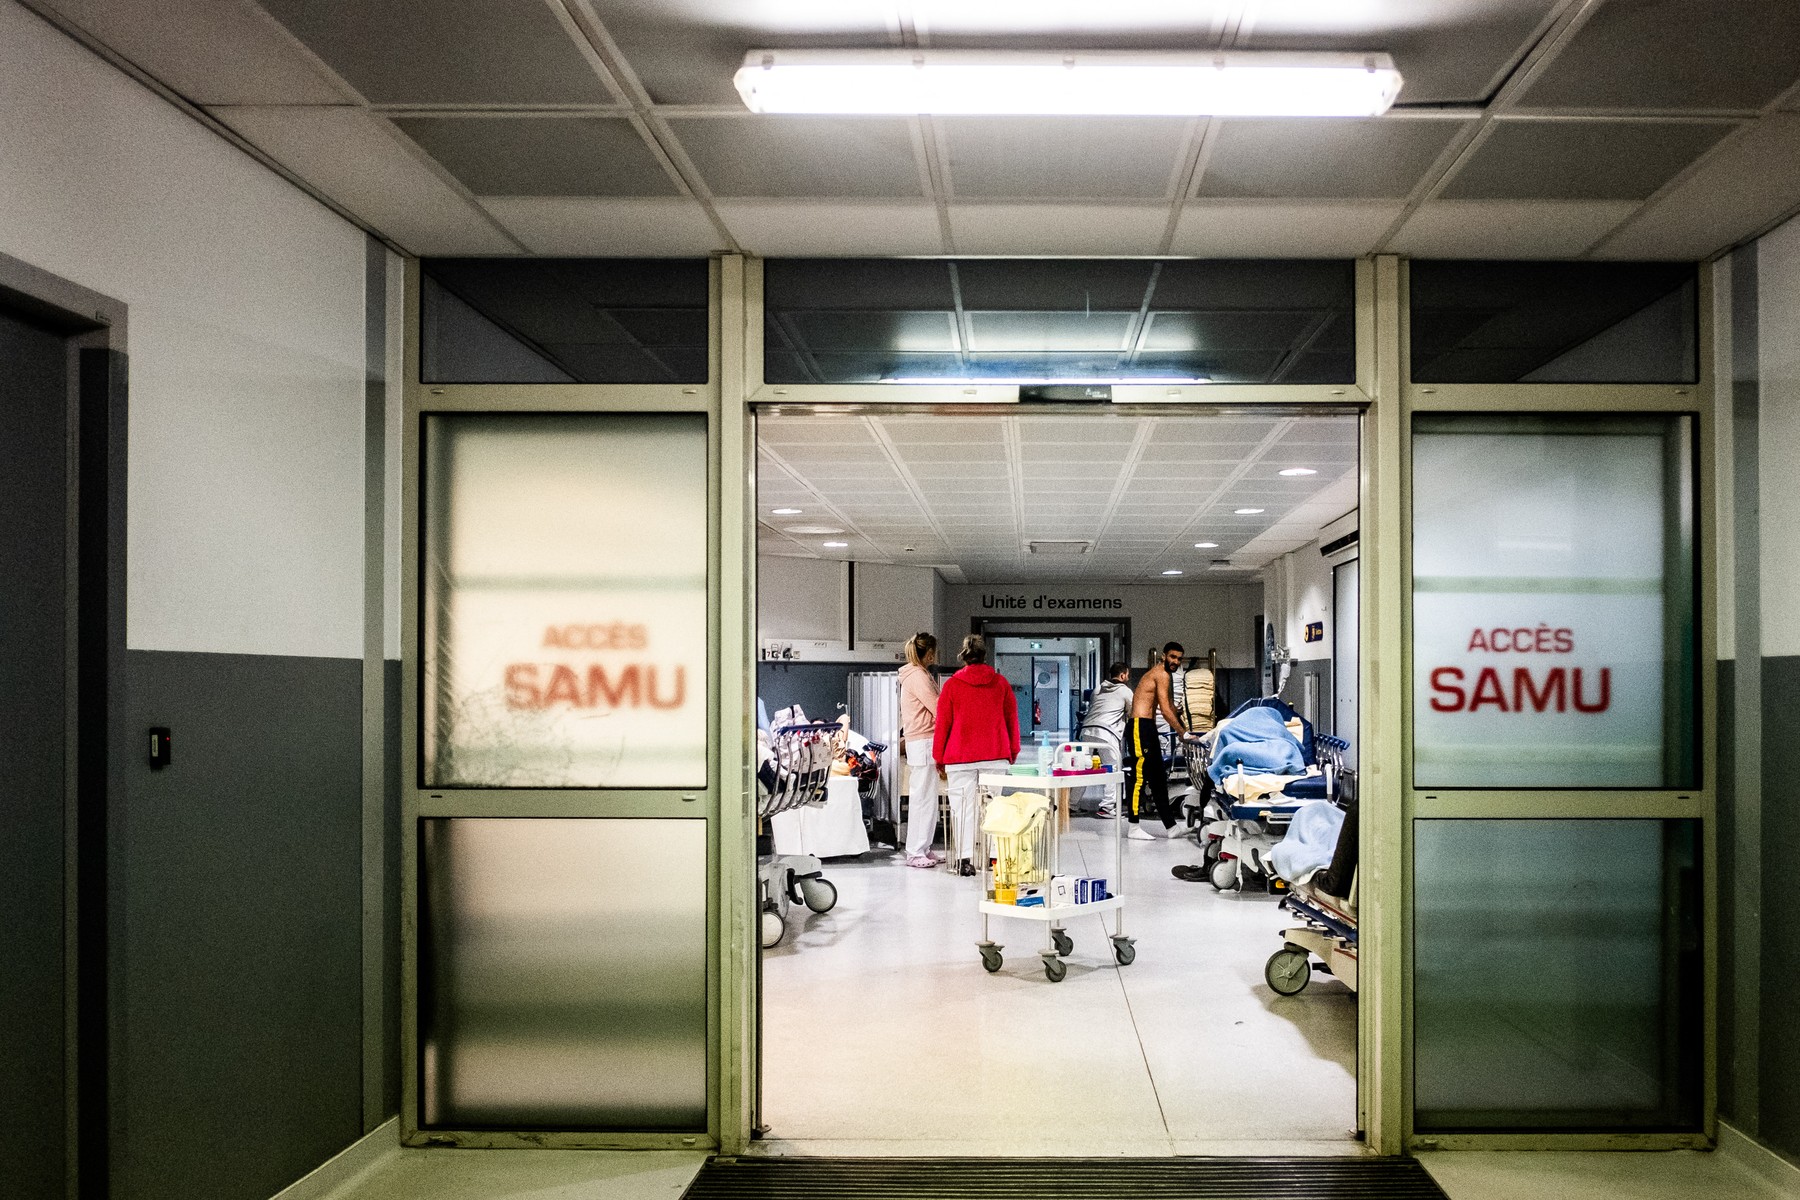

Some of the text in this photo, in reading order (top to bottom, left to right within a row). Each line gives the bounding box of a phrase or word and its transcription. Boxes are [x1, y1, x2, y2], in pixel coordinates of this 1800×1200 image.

[982, 594, 1122, 609] Unité d'examens
[1467, 622, 1574, 653] ACCÈS
[504, 663, 687, 710] SAMU
[1429, 666, 1611, 713] SAMU
